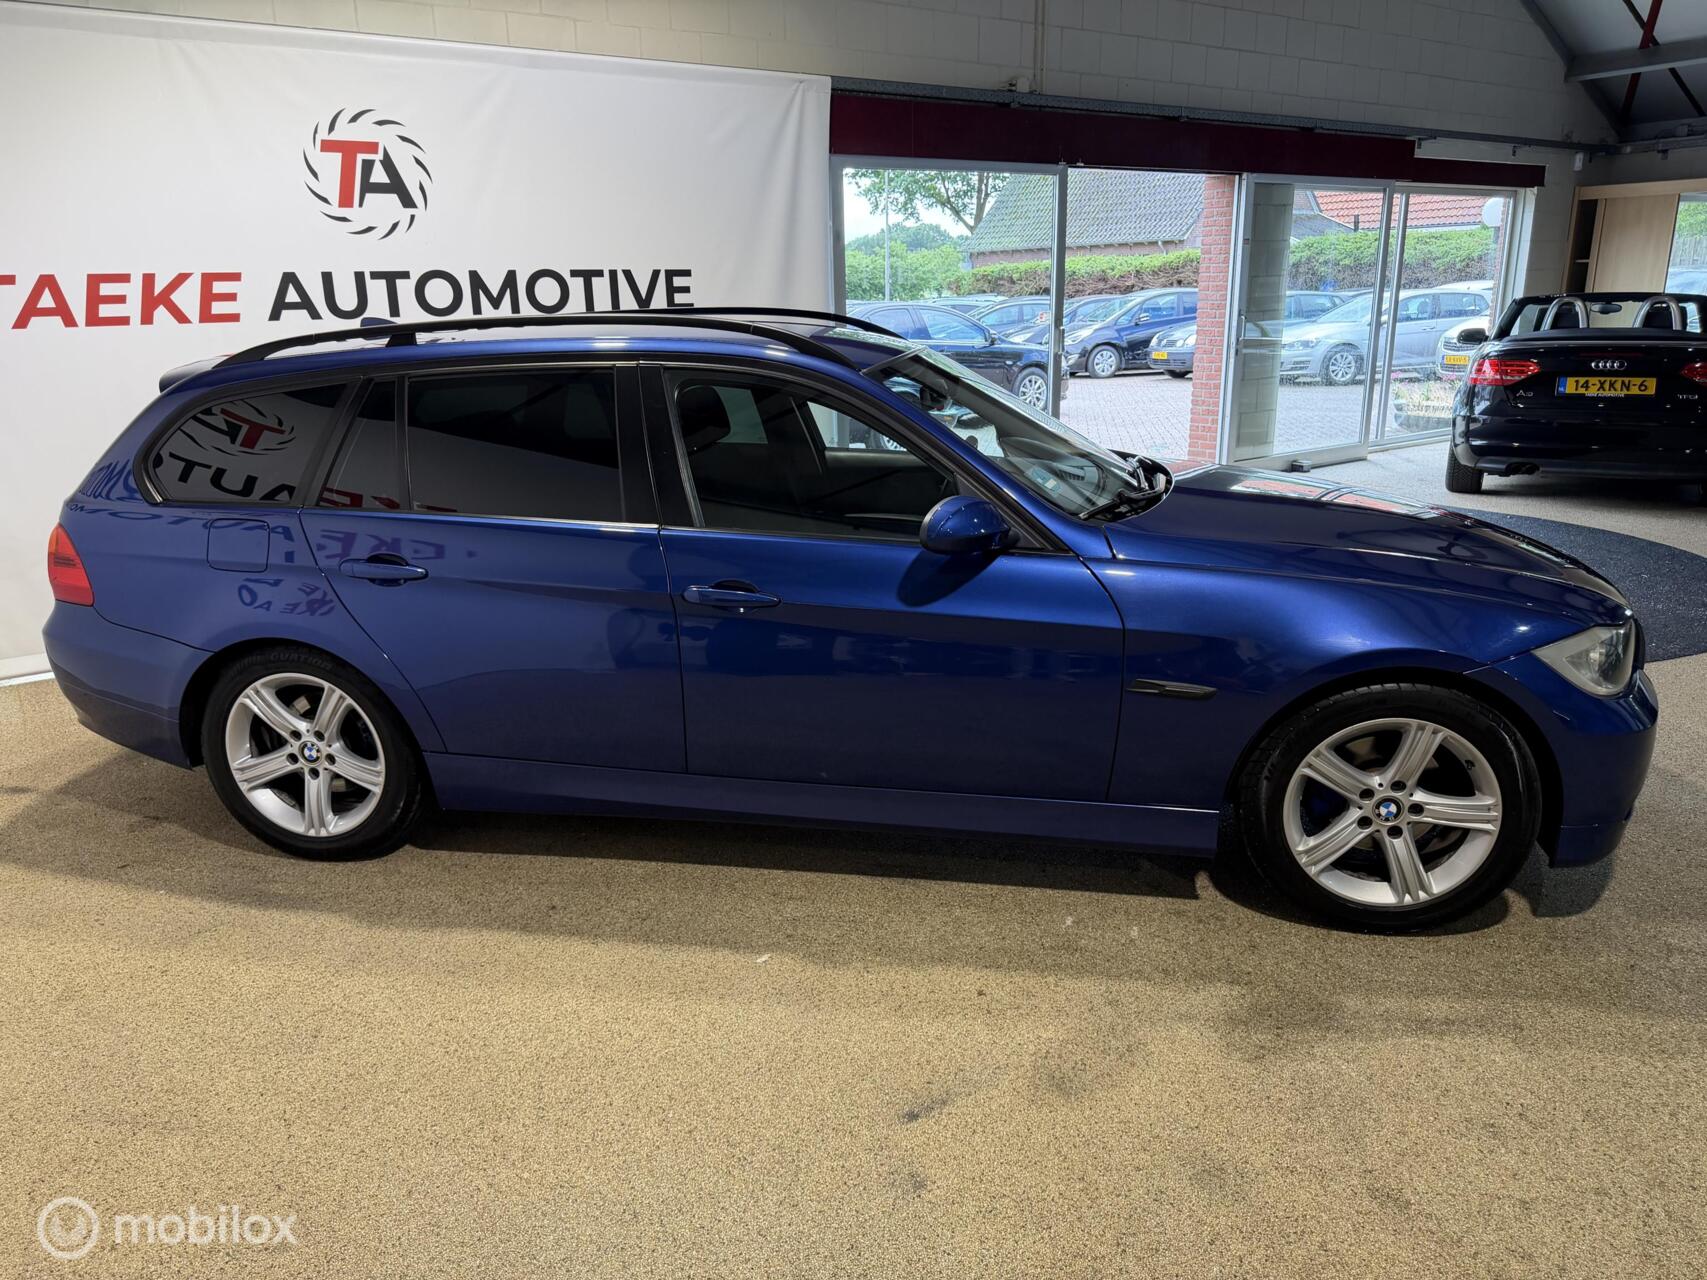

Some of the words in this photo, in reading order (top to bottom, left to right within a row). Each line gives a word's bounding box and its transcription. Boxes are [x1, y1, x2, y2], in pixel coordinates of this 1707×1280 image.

[320, 139, 418, 209] TA
[268, 268, 695, 322] AUTOMOTIVE
[1574, 380, 1648, 392] 14-XKN-6
